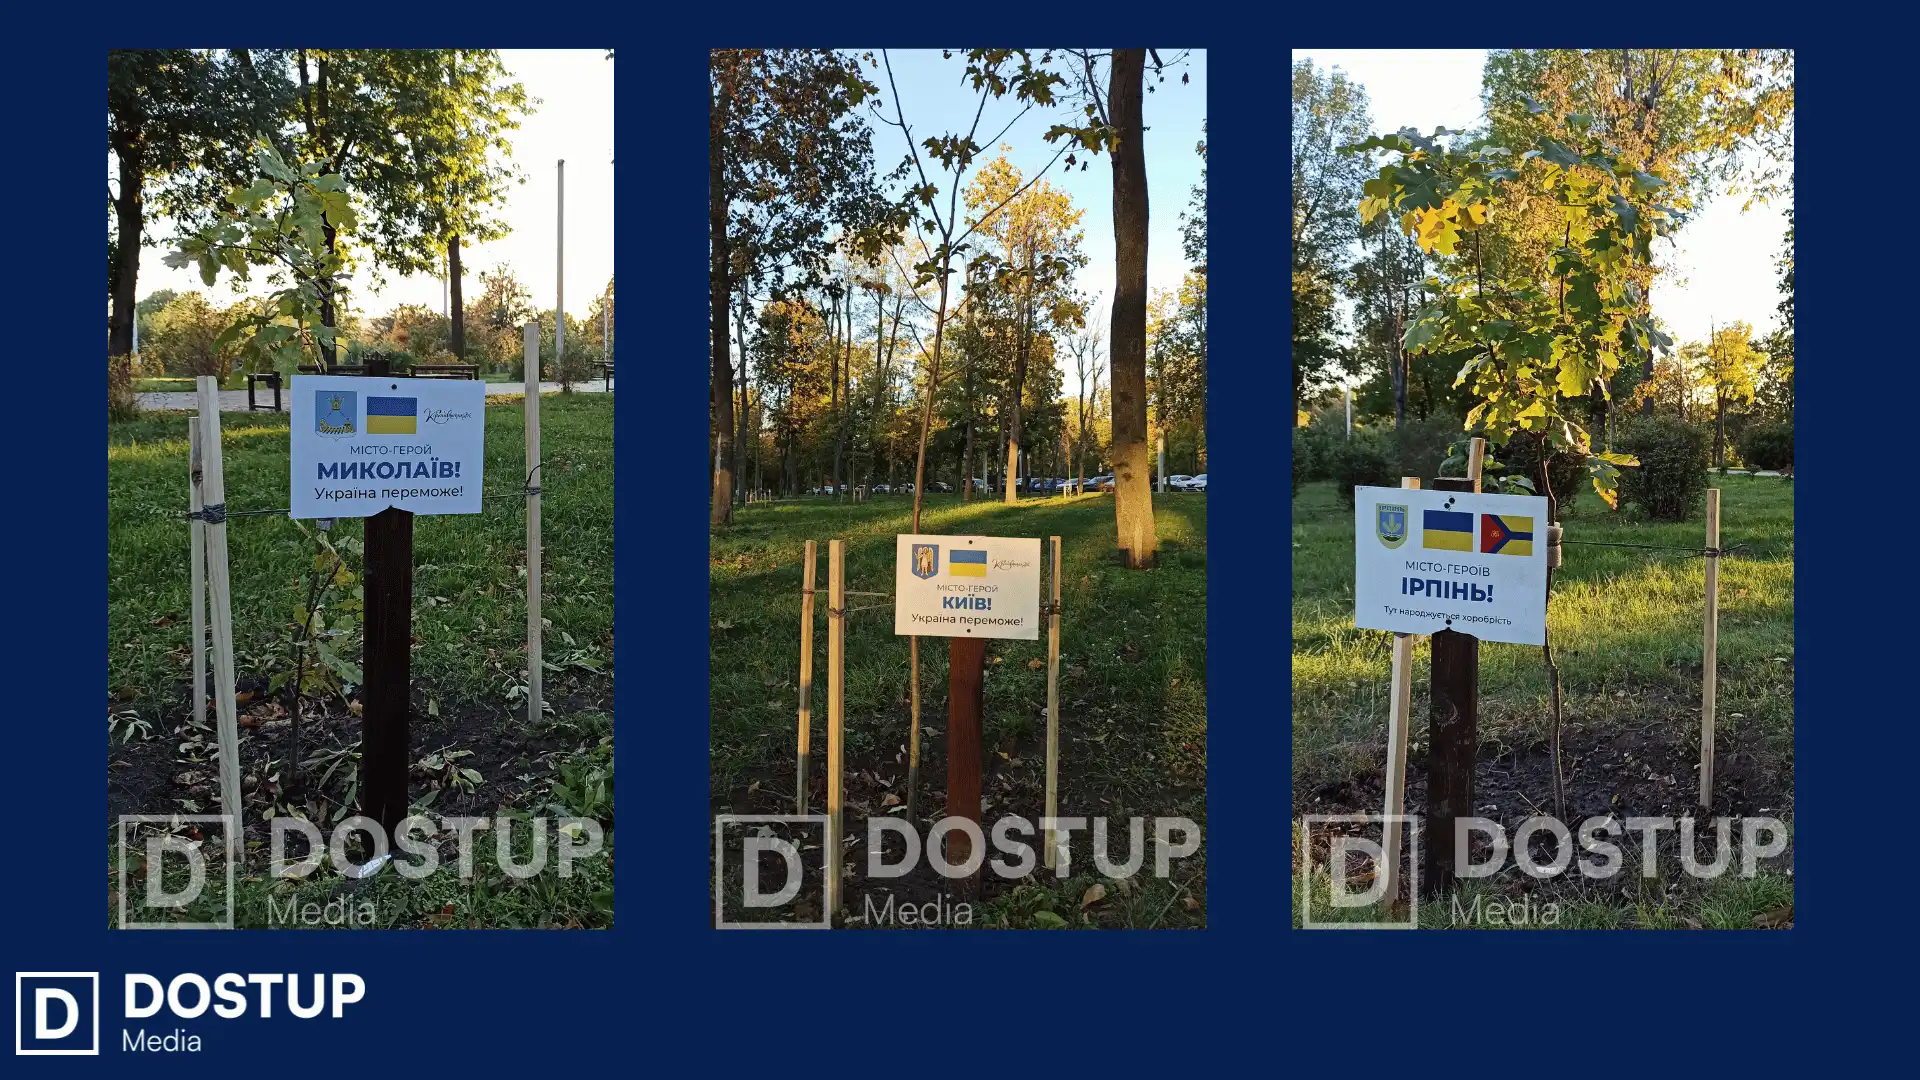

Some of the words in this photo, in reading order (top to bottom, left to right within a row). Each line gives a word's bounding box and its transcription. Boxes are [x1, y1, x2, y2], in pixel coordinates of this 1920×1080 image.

[350, 444, 432, 455] МІСТО-ГЕРОЙ
[317, 457, 461, 480] МИКОЛАЇВ!
[315, 487, 376, 502] Україна
[381, 486, 463, 501] переможе!
[1405, 561, 1490, 577] МІСТО-ГЕРОЇВ
[936, 584, 999, 593] МІСТО-ГЕРОЙ
[1401, 577, 1494, 603] ІРПІНЬ!
[942, 594, 992, 611] КИЇВ!
[911, 613, 956, 624] Україна
[959, 616, 1024, 627] переможе!
[1384, 606, 1397, 615] Тут
[1400, 609, 1460, 621] народжується
[1462, 615, 1512, 626] хоробрість
